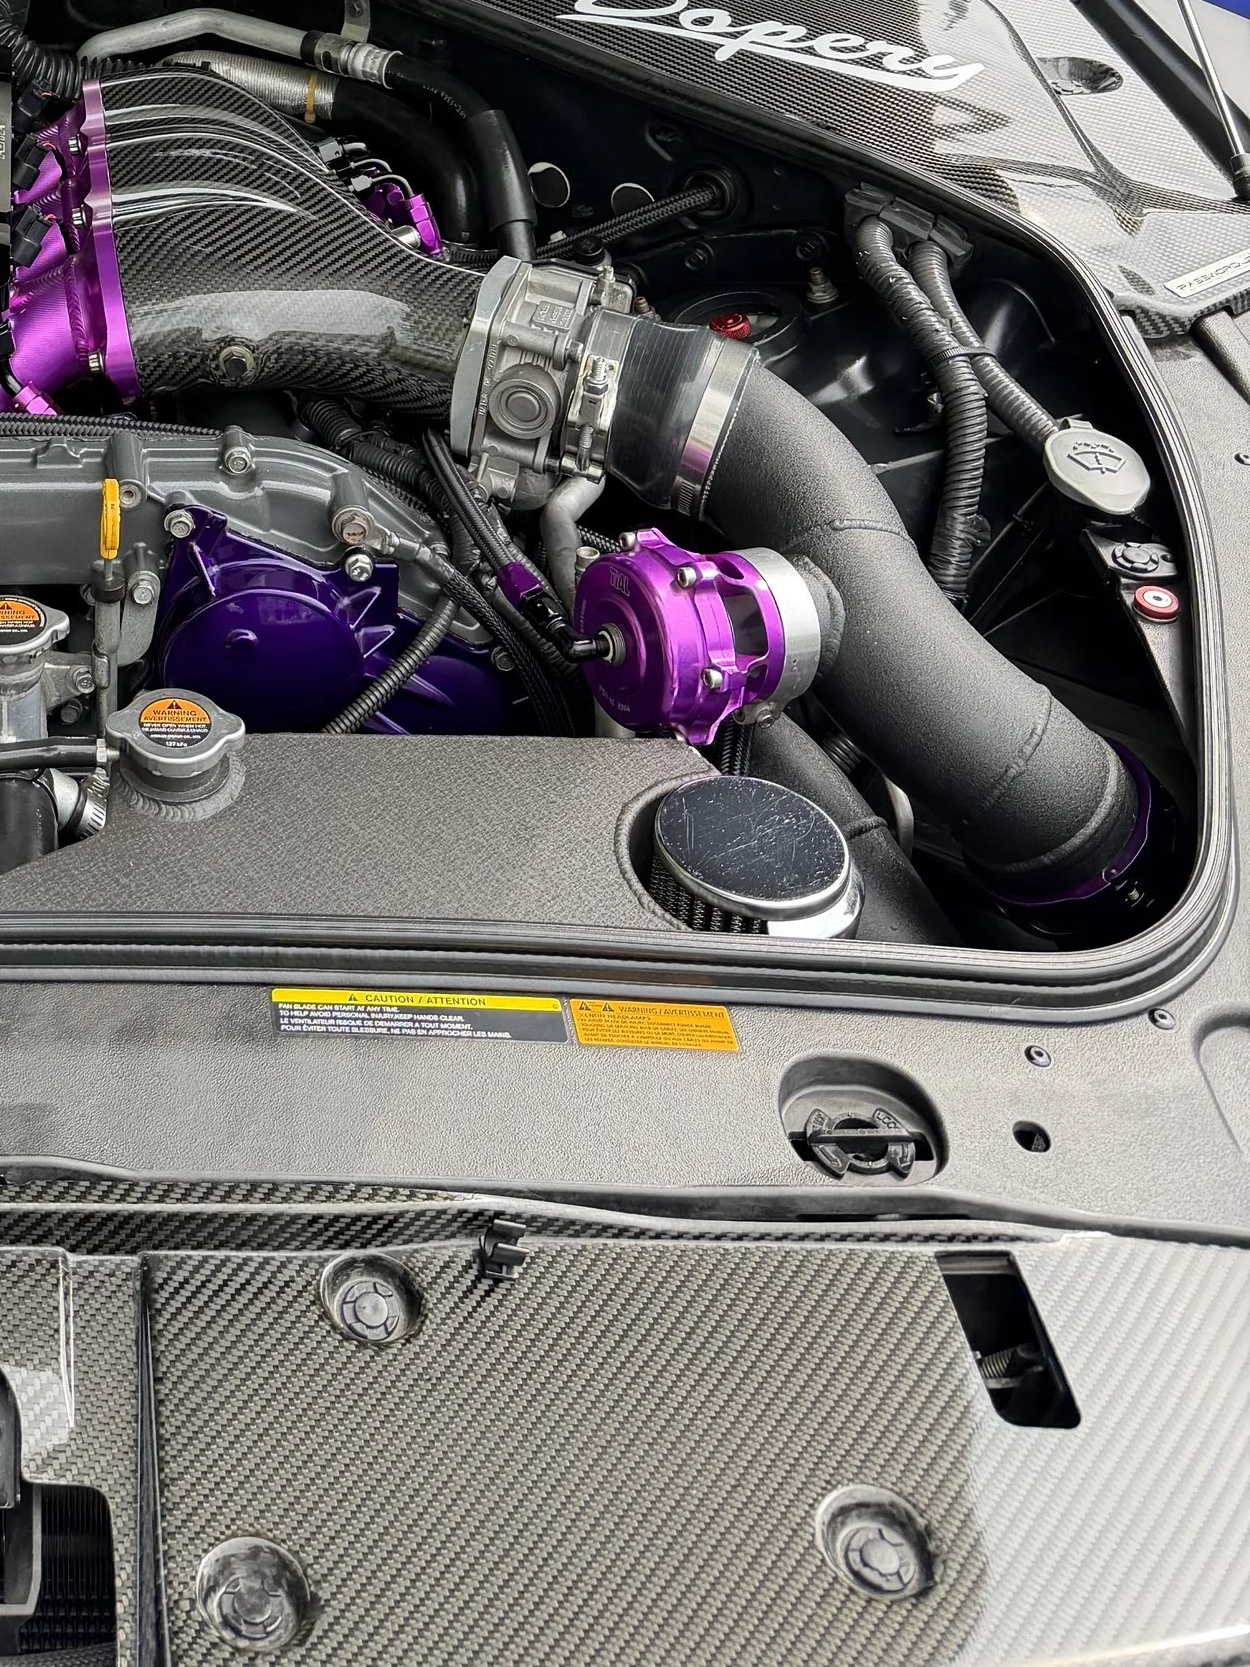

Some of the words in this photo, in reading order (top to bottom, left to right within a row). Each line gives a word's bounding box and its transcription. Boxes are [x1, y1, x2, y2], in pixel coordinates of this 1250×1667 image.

[365, 994, 414, 1004] CAUTION
[426, 996, 486, 1006] ATTENTION
[332, 1011, 370, 1019] PERSONAL
[618, 1006, 657, 1015] WARNING
[289, 1017, 336, 1026] VENTILATEUR
[327, 1025, 350, 1033] TOUTE
